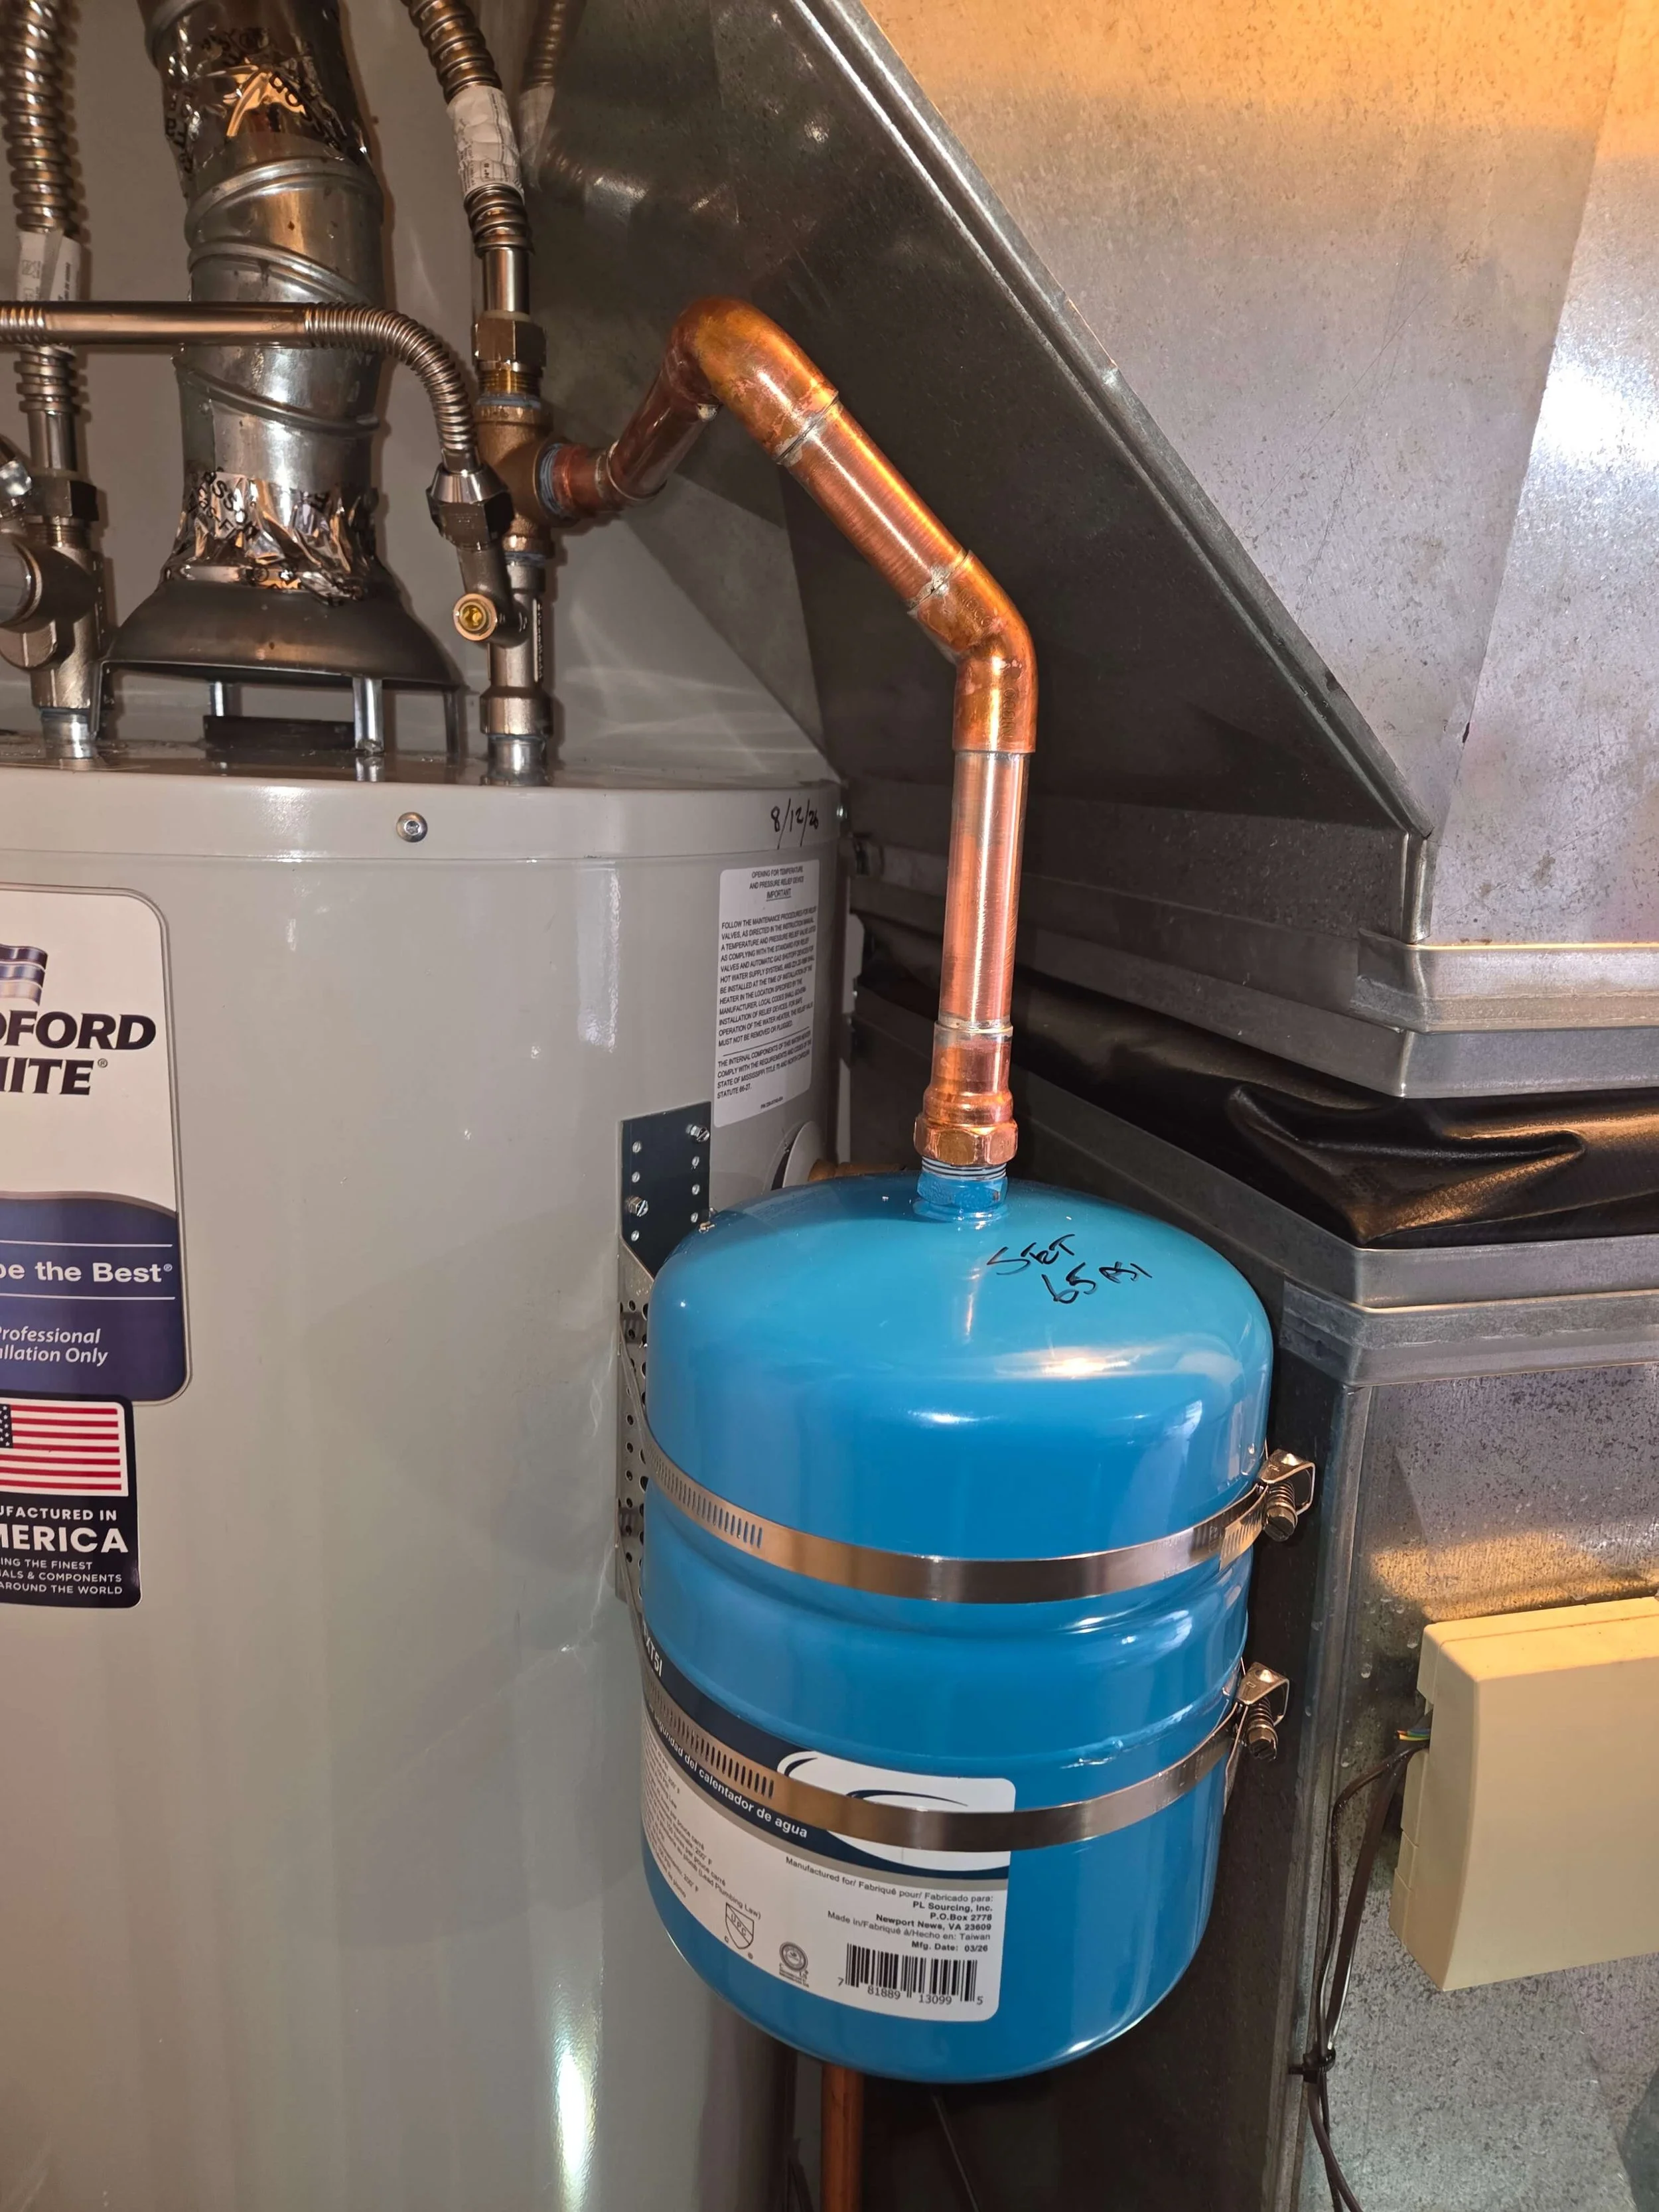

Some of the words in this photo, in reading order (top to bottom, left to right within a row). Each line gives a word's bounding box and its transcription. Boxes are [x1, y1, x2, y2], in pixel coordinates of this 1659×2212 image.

[766, 888, 791, 899] IMPORTANT
[722, 921, 743, 929] FOLLOW
[749, 926, 770, 936] DIRECTED
[726, 938, 760, 950] TEMPERATURE
[760, 936, 768, 945] AND
[729, 950, 756, 961] COMPLYING
[721, 963, 740, 973] VALVES
[740, 960, 750, 970] AND
[720, 975, 731, 984] HOT
[731, 972, 749, 982] WATER
[749, 969, 764, 978] SUPPLY
[719, 986, 727, 995] BE
[728, 982, 753, 993] INSTALLED
[759, 978, 768, 987] THE
[719, 995, 739, 1005] HEATER
[745, 992, 755, 1000] THE
[754, 986, 775, 997] LOCATION
[758, 997, 771, 1007] LOCAL
[719, 1012, 752, 1026] INSTALLATION
[752, 1010, 758, 1019] OF
[718, 1024, 747, 1037] OPERATION
[747, 1022, 754, 1031] OF
[754, 1019, 762, 1029] THE
[718, 1037, 733, 1048] MUST
[733, 1035, 744, 1044] NOT
[743, 1033, 751, 1041] BE
[750, 1027, 771, 1039] REMOVED
[717, 1059, 729, 1069] THE
[729, 1053, 751, 1066] INTERNAL
[751, 1045, 779, 1059] COMPONENTS
[717, 1068, 738, 1079] COMPLY
[738, 1064, 751, 1074] WITH
[751, 1061, 760, 1070] THE
[717, 1078, 734, 1089] STATE
[733, 1076, 741, 1085] OF
[717, 1086, 739, 1100] STATUTE
[35, 1262, 82, 1282] the
[0, 1325, 102, 1345] rofessional
[65, 1347, 109, 1367] Only
[100, 1509, 117, 1522] IN
[24, 1558, 48, 1569] THE
[51, 1560, 93, 1571] FINEST
[27, 1571, 35, 1580] &
[38, 1572, 122, 1583] COMPONENTS
[50, 1584, 74, 1594] THE
[78, 1586, 123, 1595] WORLD
[685, 1754, 697, 1771] del
[699, 1768, 755, 1813] calentador
[756, 1805, 772, 1822] de
[774, 1817, 809, 1839] agua
[786, 1856, 840, 1883] Manufactured
[842, 1876, 857, 1886] for/
[859, 1881, 897, 1897] Fabriqué
[899, 1889, 922, 1900] pour/
[925, 1892, 970, 1903] Fabricado
[971, 1895, 994, 1905] para:
[715, 1882, 743, 1909] Plumbing
[744, 1903, 761, 1920] Law)
[912, 1901, 925, 1909] PL
[928, 1902, 974, 1913] Sourcing,
[828, 1910, 851, 1924] Made
[876, 1913, 915, 1928] Newport
[918, 1919, 946, 1931] News,
[911, 1940, 931, 1951] Mfg.
[934, 1943, 958, 1951] Date:
[964, 1944, 988, 1953] 03/26
[837, 1977, 844, 1986] 7
[867, 1985, 901, 2000] 81889
[918, 1994, 953, 2006] 13099
[976, 1996, 984, 2006] 5
